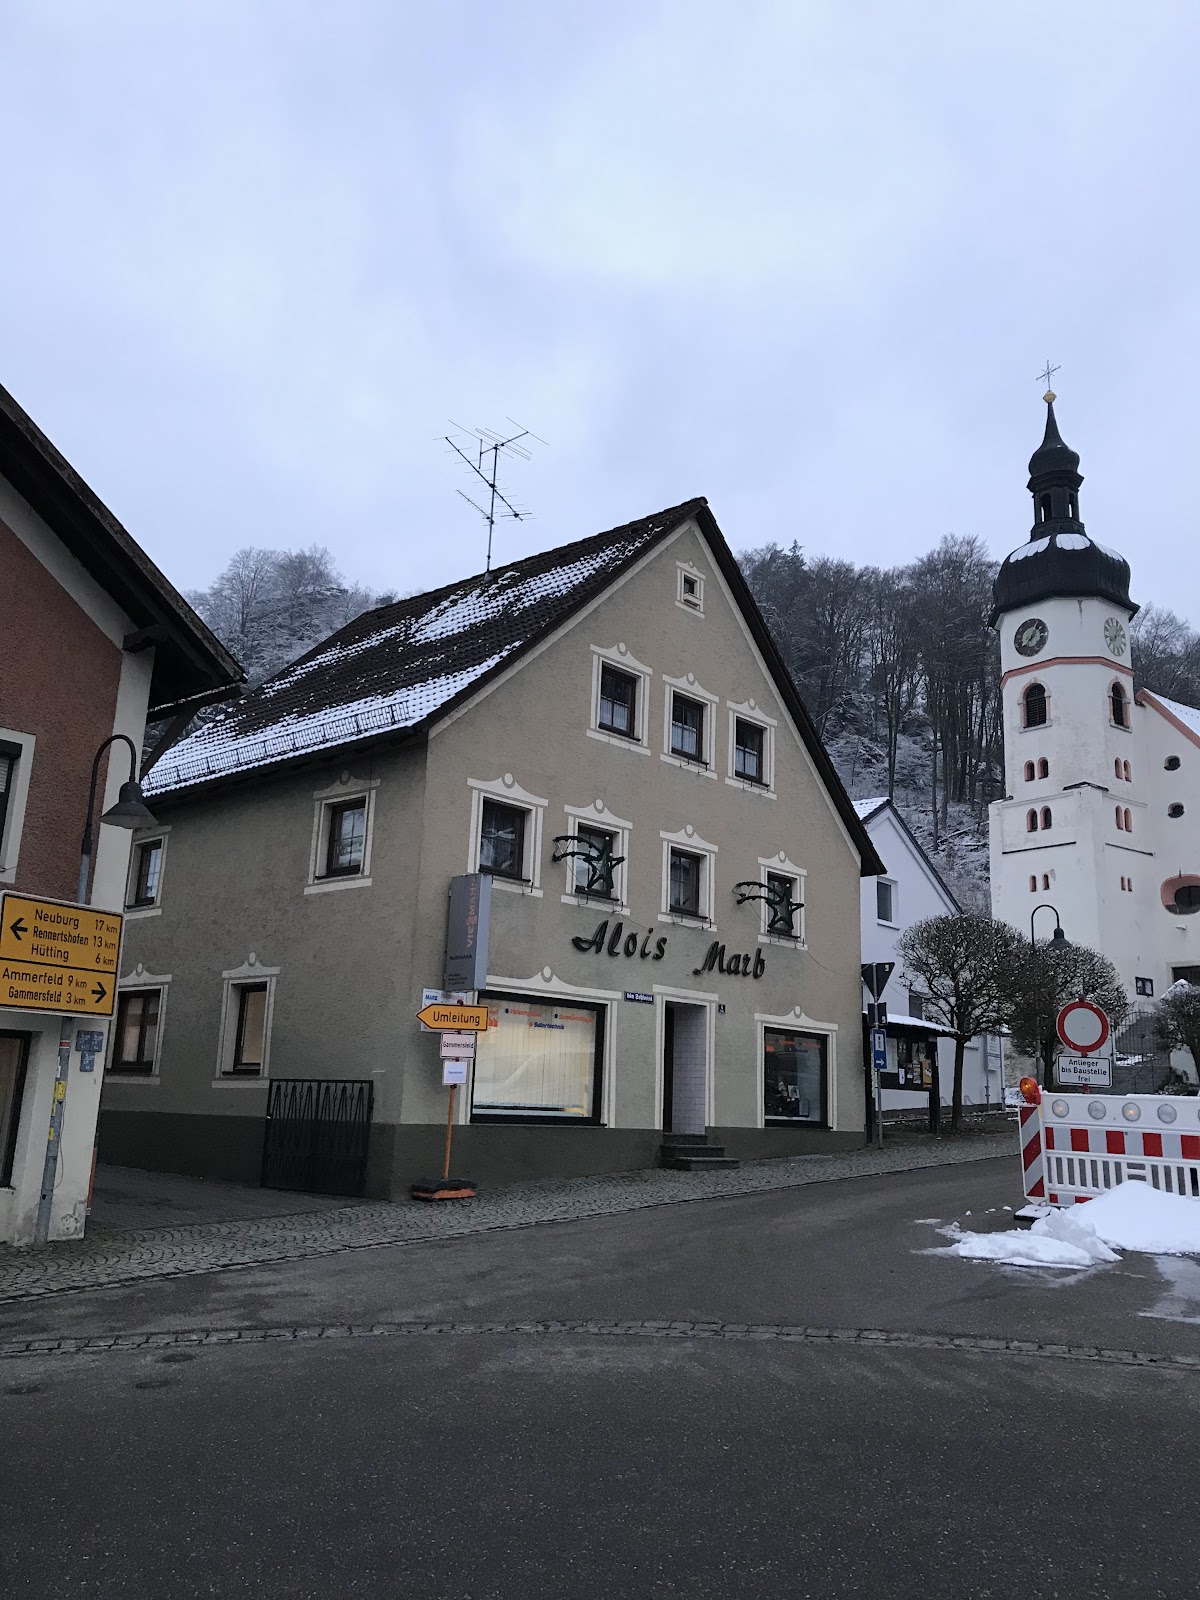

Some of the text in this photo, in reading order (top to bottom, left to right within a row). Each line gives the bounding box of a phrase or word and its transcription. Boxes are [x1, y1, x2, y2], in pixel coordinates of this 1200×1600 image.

[34, 909, 118, 934] Neuburg 17 km
[33, 925, 116, 950] Rennertshofen 13 km
[31, 943, 115, 966] Hütting 6 km
[571, 919, 766, 980] Alois Marb
[2, 967, 88, 989] Ammerfeld 9 km
[8, 985, 86, 1005] Gammersfeld 3 km
[433, 1010, 481, 1026] Umleitung
[442, 1041, 474, 1049] Gammersfeld
[1068, 1059, 1099, 1068] Anlieger
[1073, 1067, 1107, 1076] Baustelle
